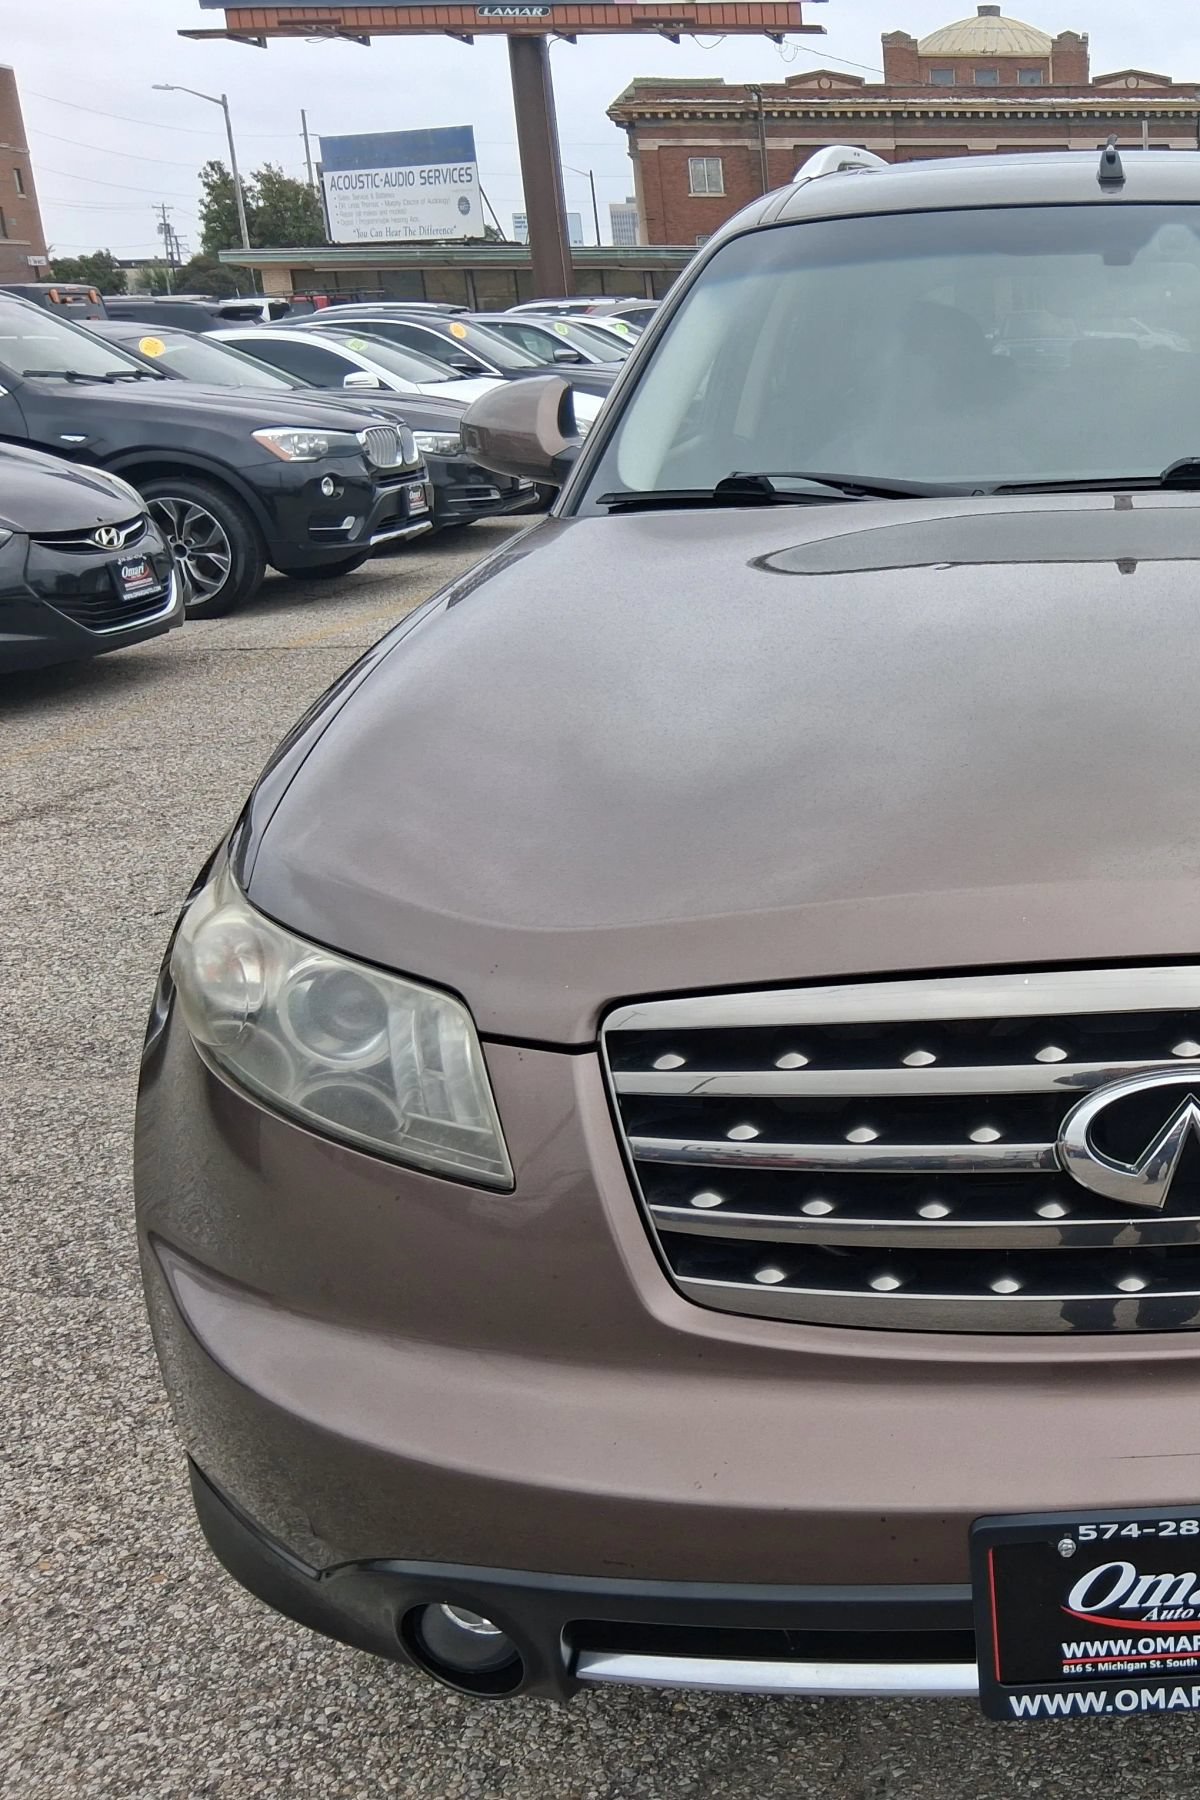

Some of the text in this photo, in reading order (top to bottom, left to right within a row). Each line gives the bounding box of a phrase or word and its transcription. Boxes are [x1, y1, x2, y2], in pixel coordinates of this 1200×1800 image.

[483, 7, 543, 16] LAMAR
[420, 167, 473, 185] SERVICES
[370, 229, 383, 238] Can
[385, 227, 401, 237] Hear
[403, 226, 417, 236] The
[121, 562, 145, 578] Omari
[1141, 1607, 1195, 1621] Auto
[1063, 1664, 1083, 1674] 816
[1085, 1663, 1095, 1672] S.
[1098, 1660, 1147, 1672] Michigan
[1150, 1659, 1164, 1669] St.
[1166, 1657, 1198, 1668] South
